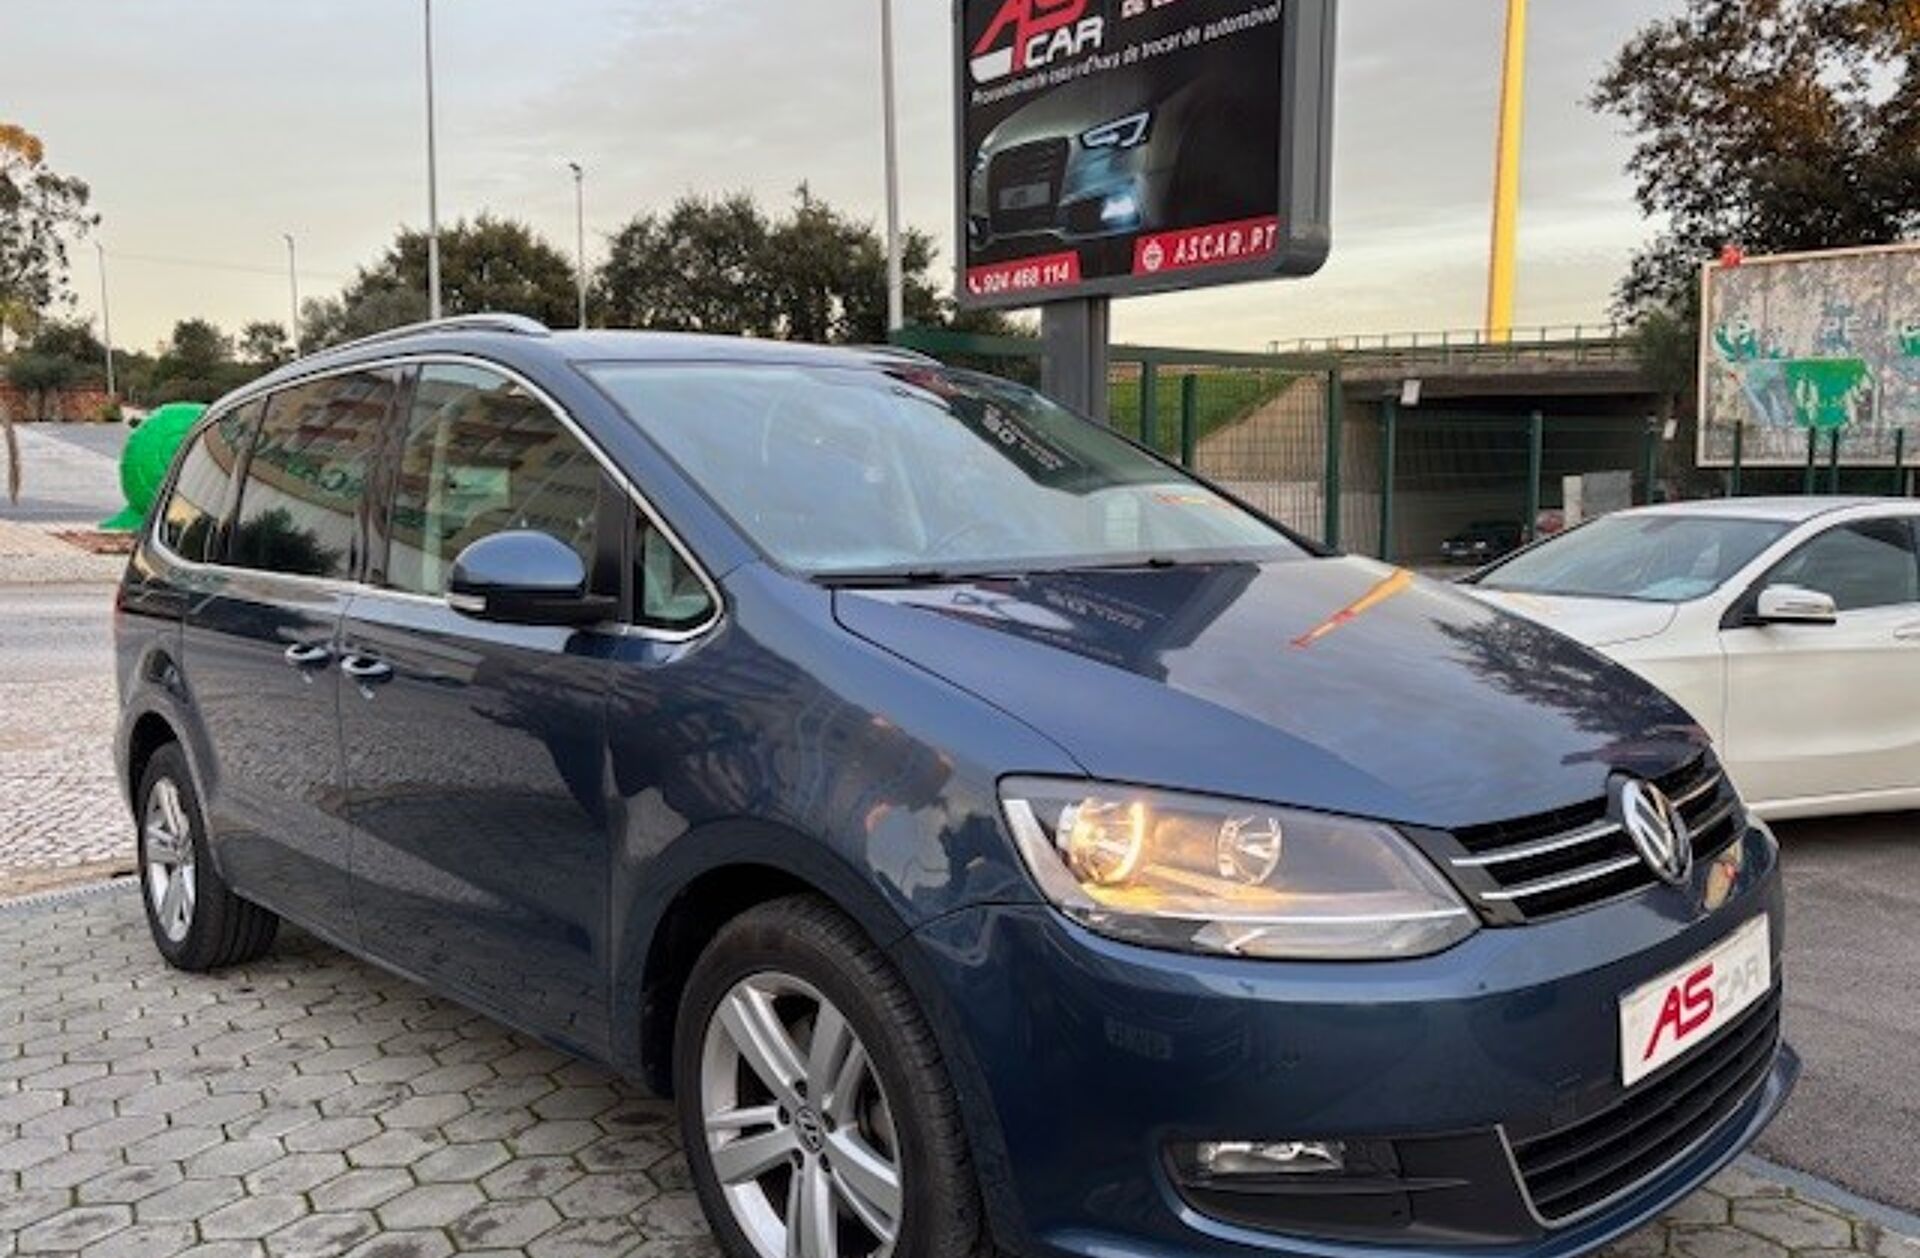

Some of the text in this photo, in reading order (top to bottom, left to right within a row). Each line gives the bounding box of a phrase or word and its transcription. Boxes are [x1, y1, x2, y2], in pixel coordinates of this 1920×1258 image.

[1023, 15, 1104, 68] CAR
[1173, 224, 1277, 265] ASCAR.PT
[1043, 260, 1069, 285] 114
[1643, 962, 1714, 1061] AS
